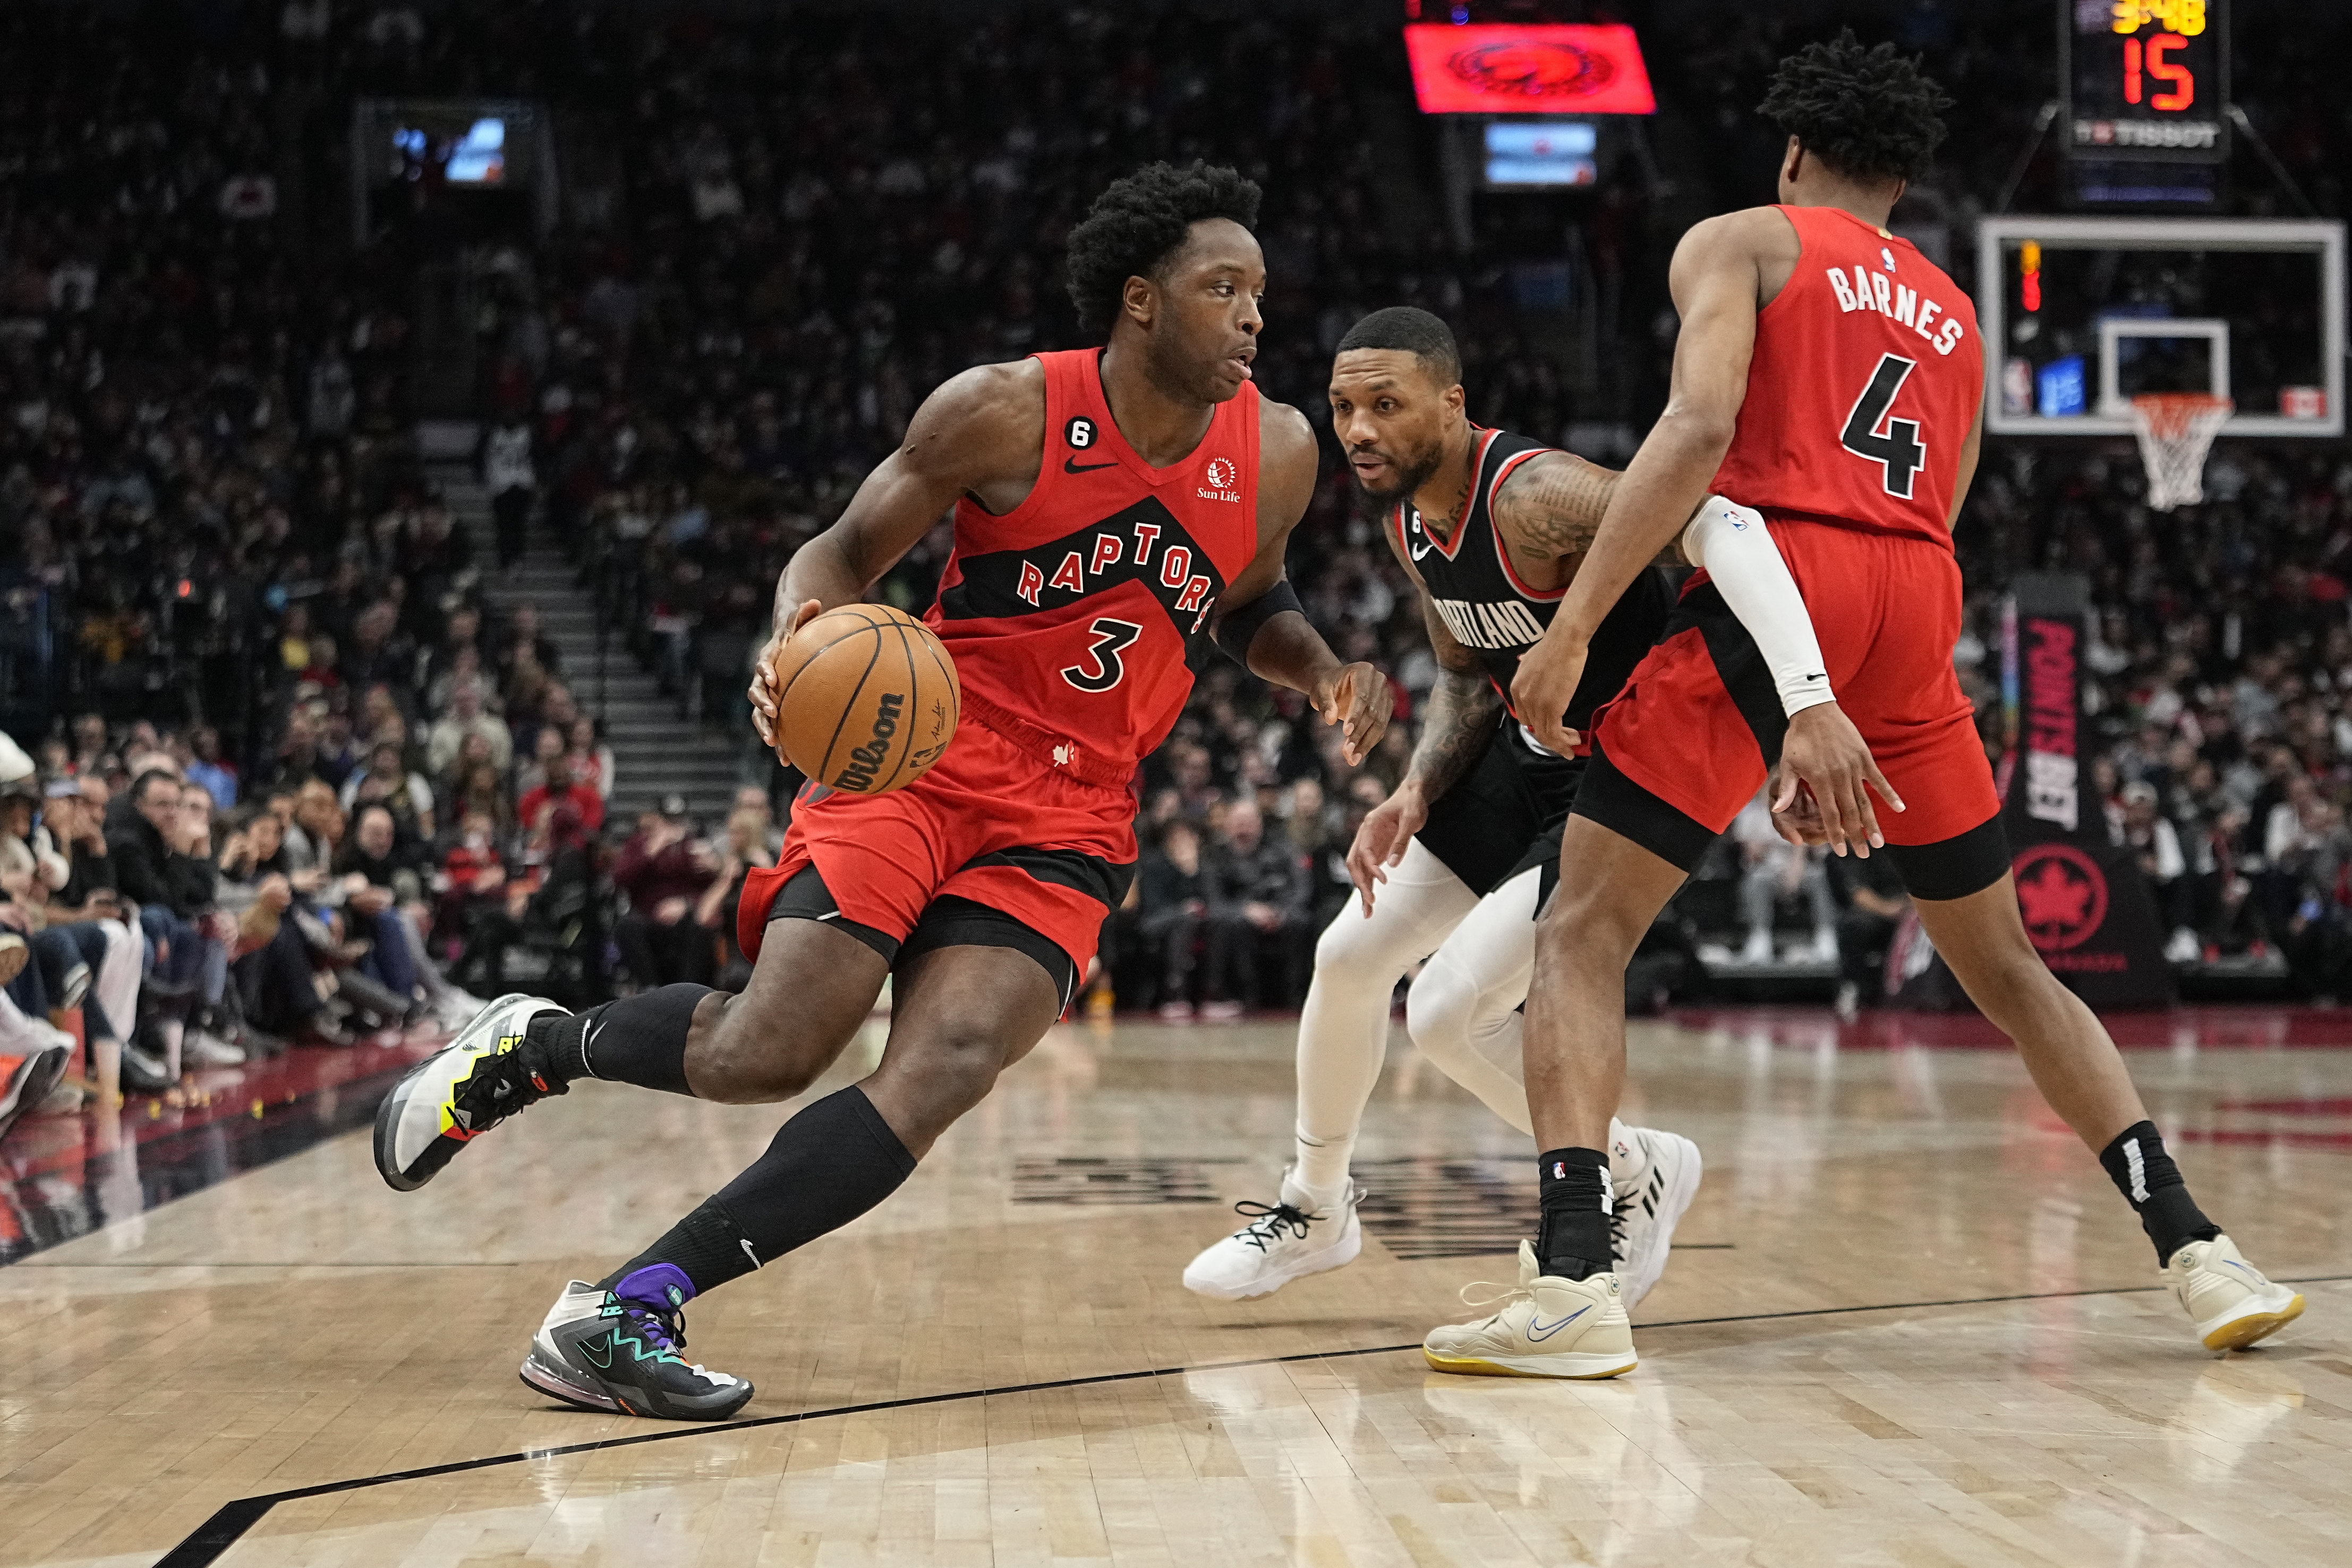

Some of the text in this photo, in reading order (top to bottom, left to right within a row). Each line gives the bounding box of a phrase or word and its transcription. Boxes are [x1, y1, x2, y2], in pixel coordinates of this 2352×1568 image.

[2124, 33, 2193, 110] 15
[1826, 266, 1964, 355] BARNES
[1071, 421, 1090, 446] 6
[1840, 352, 1927, 500] 4
[1197, 488, 1240, 503] Sun Life
[1412, 510, 1421, 533] 6
[1017, 522, 1215, 634] RAPTORS
[1060, 618, 1143, 693] 3
[1431, 595, 1545, 649] ORTLAND
[832, 693, 905, 791] Wilson
